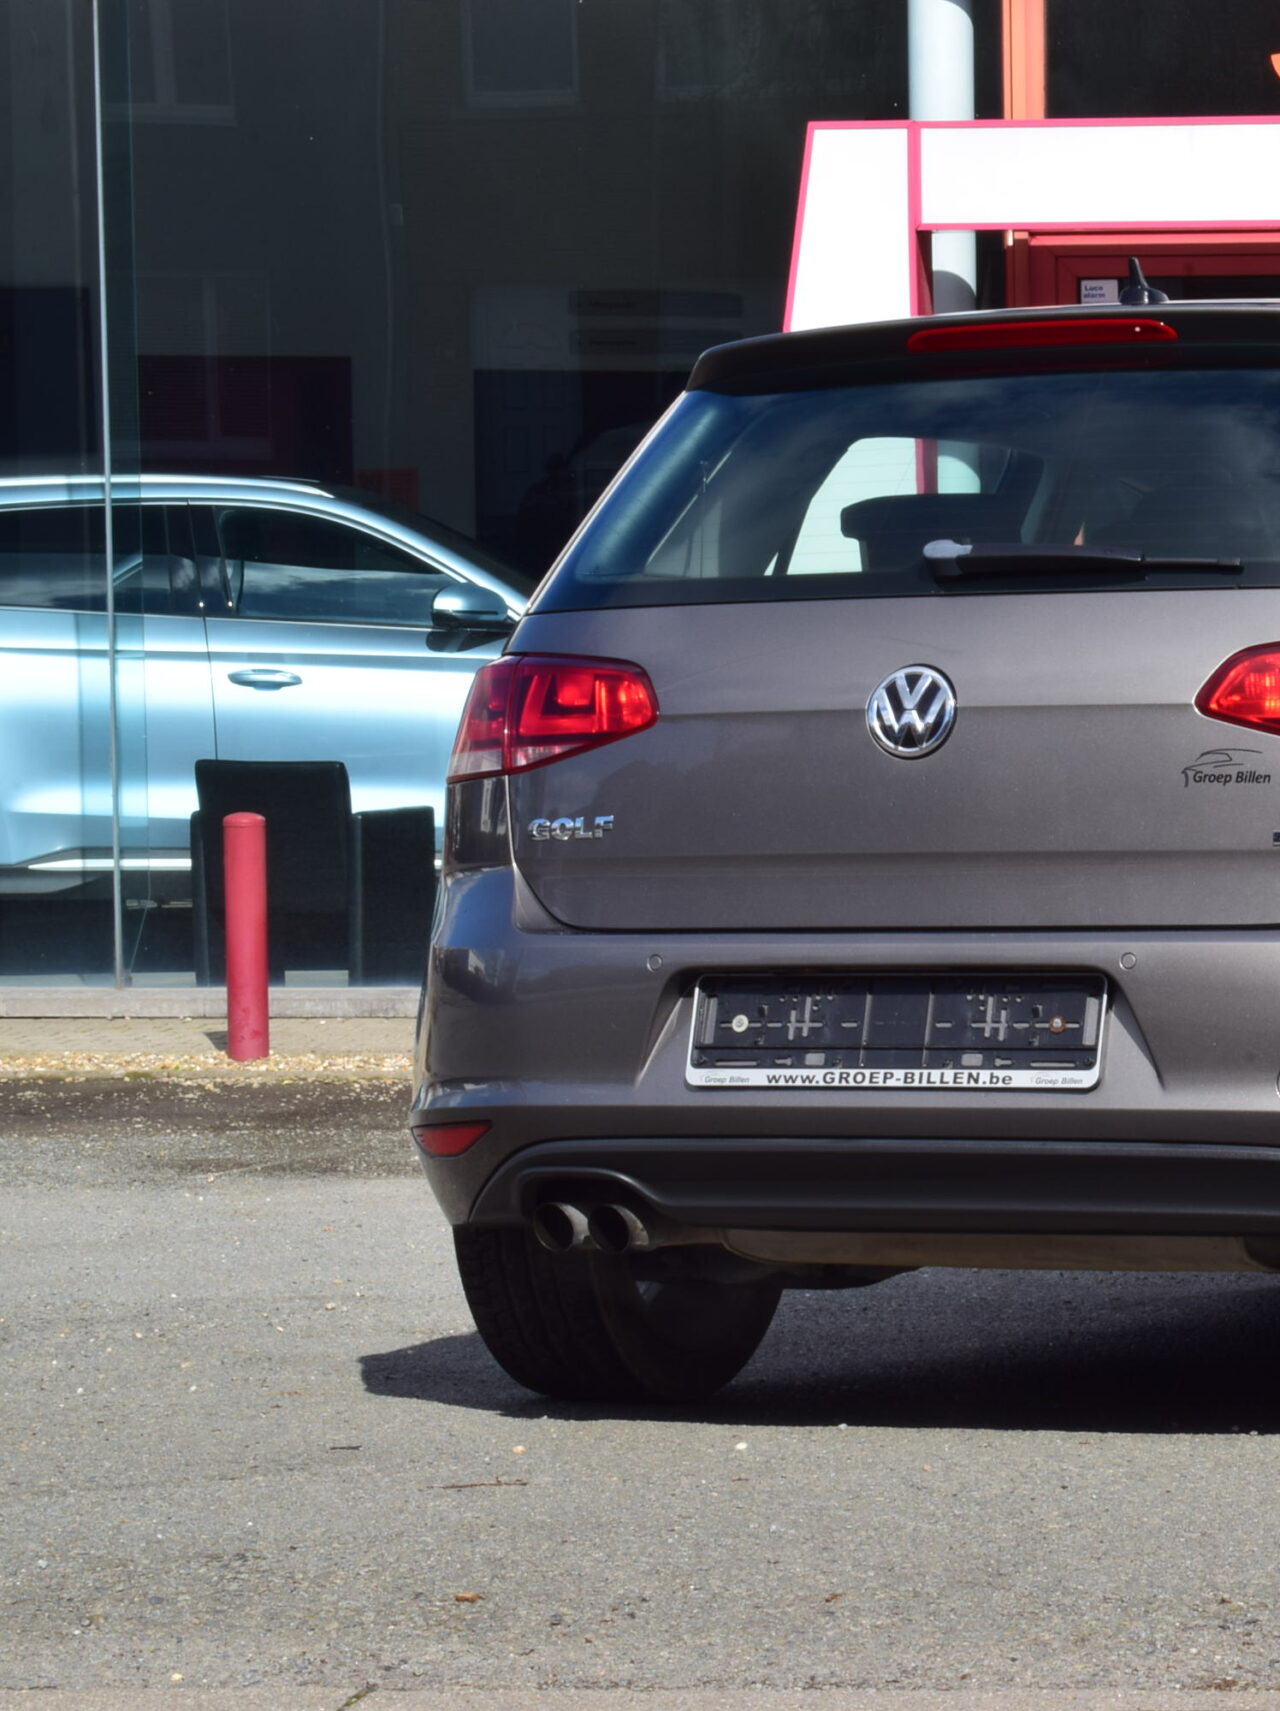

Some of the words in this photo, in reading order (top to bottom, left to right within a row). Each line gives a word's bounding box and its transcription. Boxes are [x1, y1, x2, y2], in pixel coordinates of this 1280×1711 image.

[1193, 770, 1232, 786] Groep
[1235, 770, 1271, 784] Billen
[528, 815, 614, 841] GOLF
[704, 1075, 727, 1084] Groep
[729, 1075, 750, 1083] Billen
[766, 1071, 1013, 1086] www.GROEP-BILLEN.be
